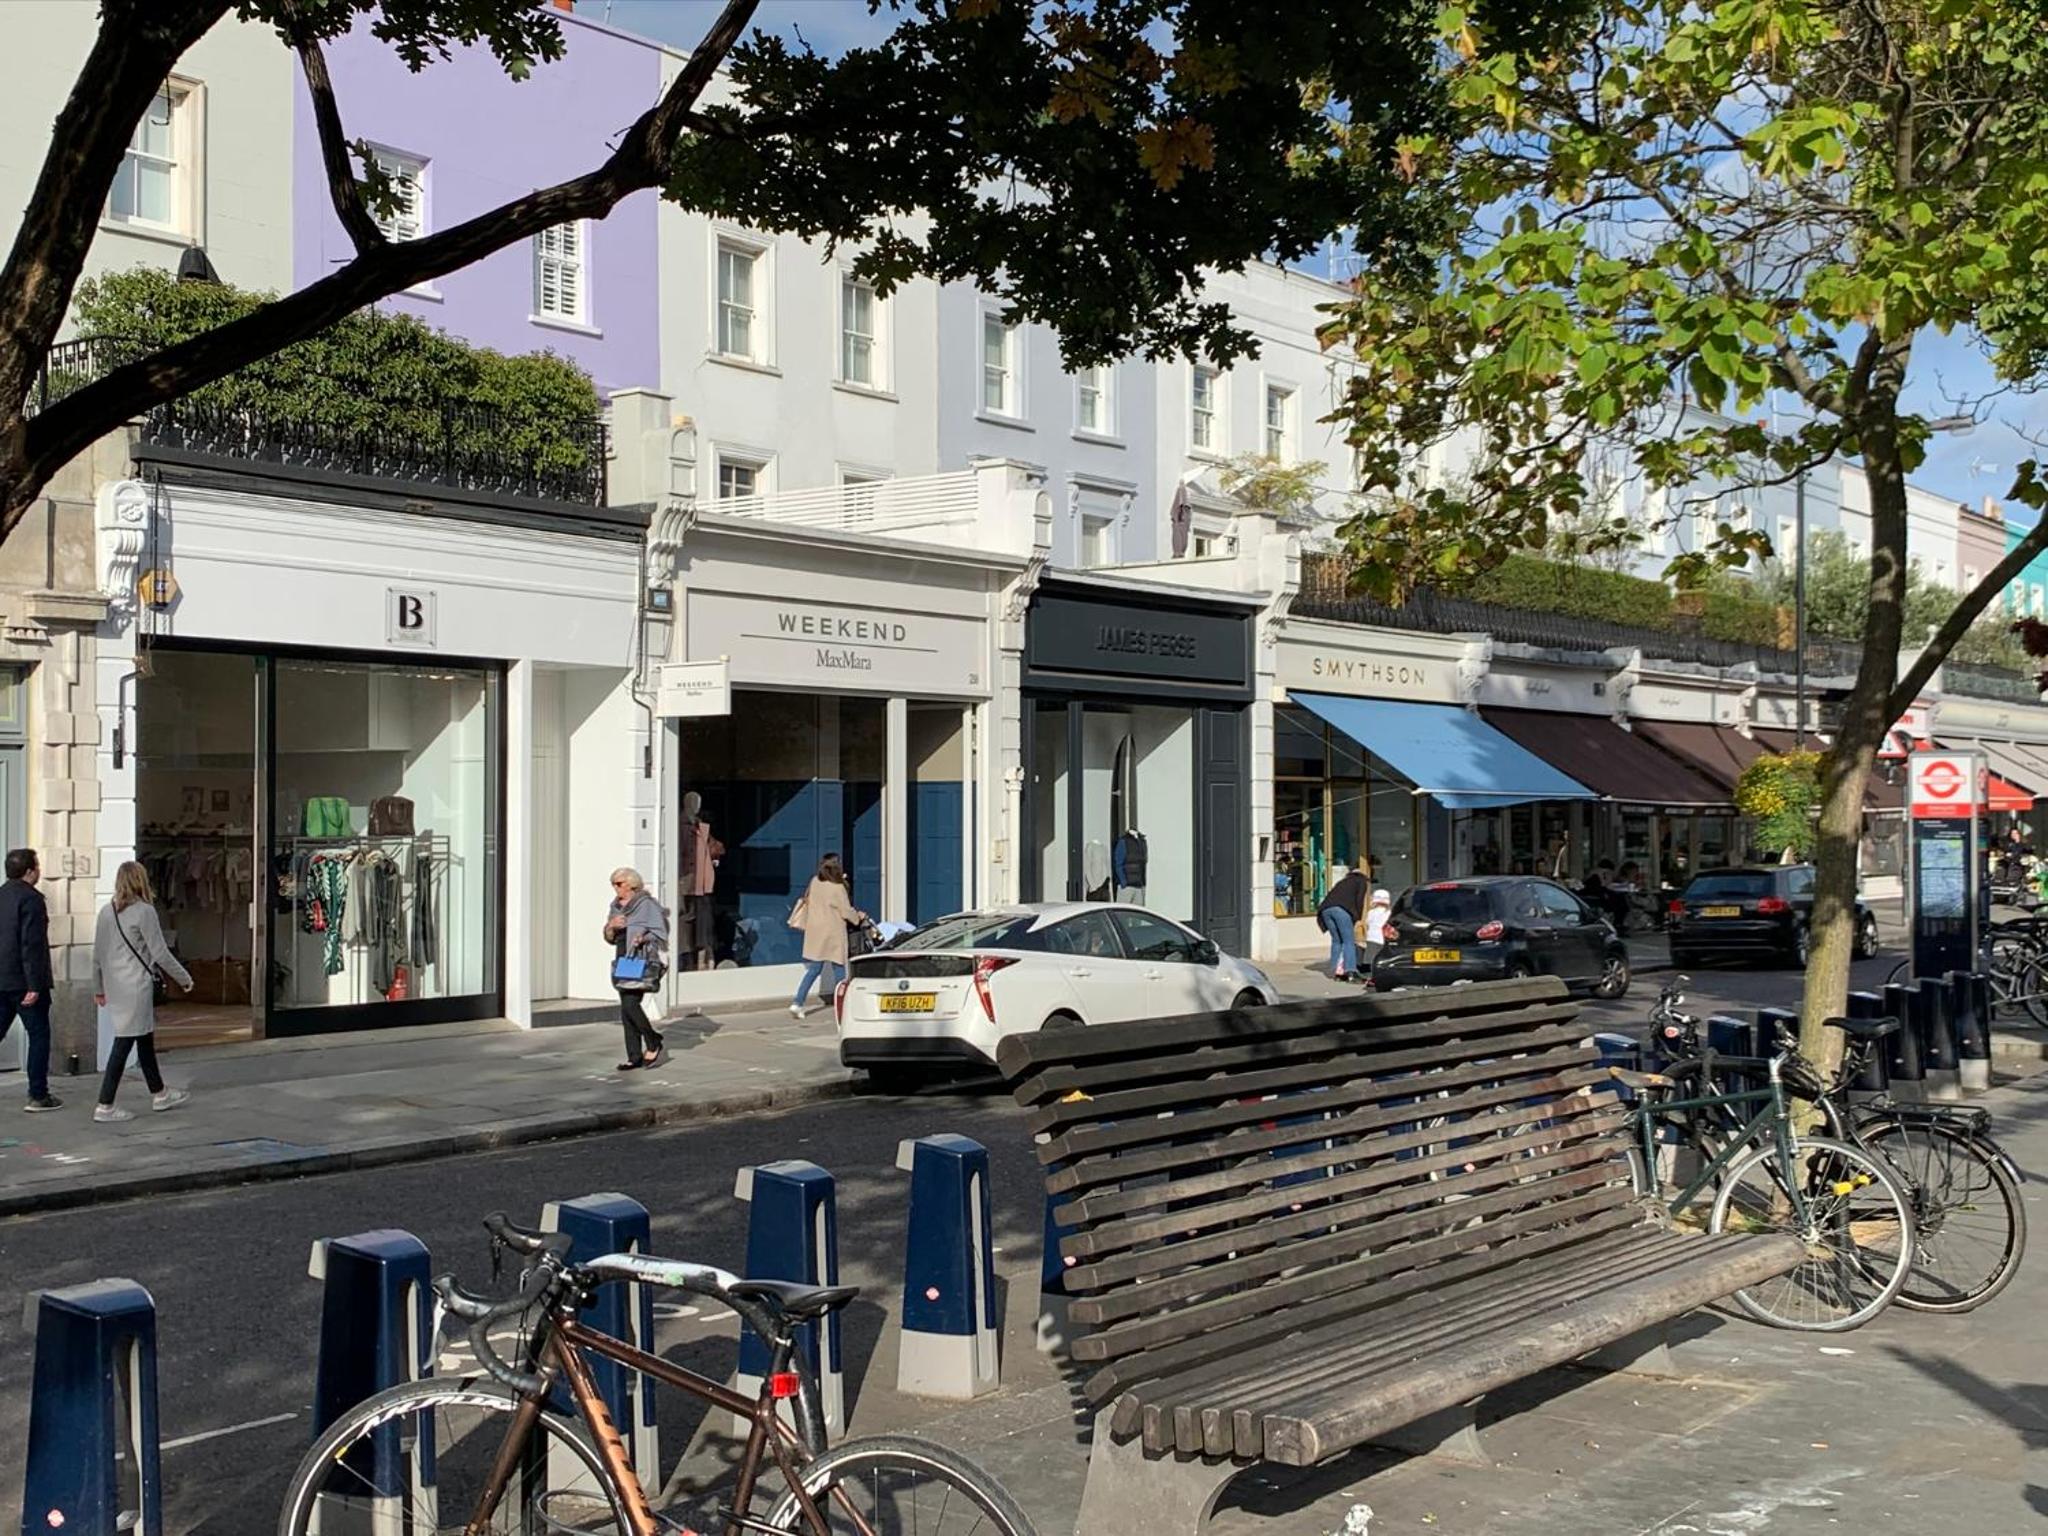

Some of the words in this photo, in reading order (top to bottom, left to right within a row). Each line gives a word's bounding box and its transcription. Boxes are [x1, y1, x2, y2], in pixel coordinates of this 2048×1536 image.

[399, 595, 423, 629] B
[778, 613, 907, 642] WEEKEND
[1096, 626, 1146, 655] JAMES
[1149, 631, 1197, 659] PERSE
[815, 649, 872, 671] MaxMara
[1312, 658, 1426, 685] SMYTHSON
[886, 998, 908, 1009] KF16
[909, 997, 930, 1008] UZH
